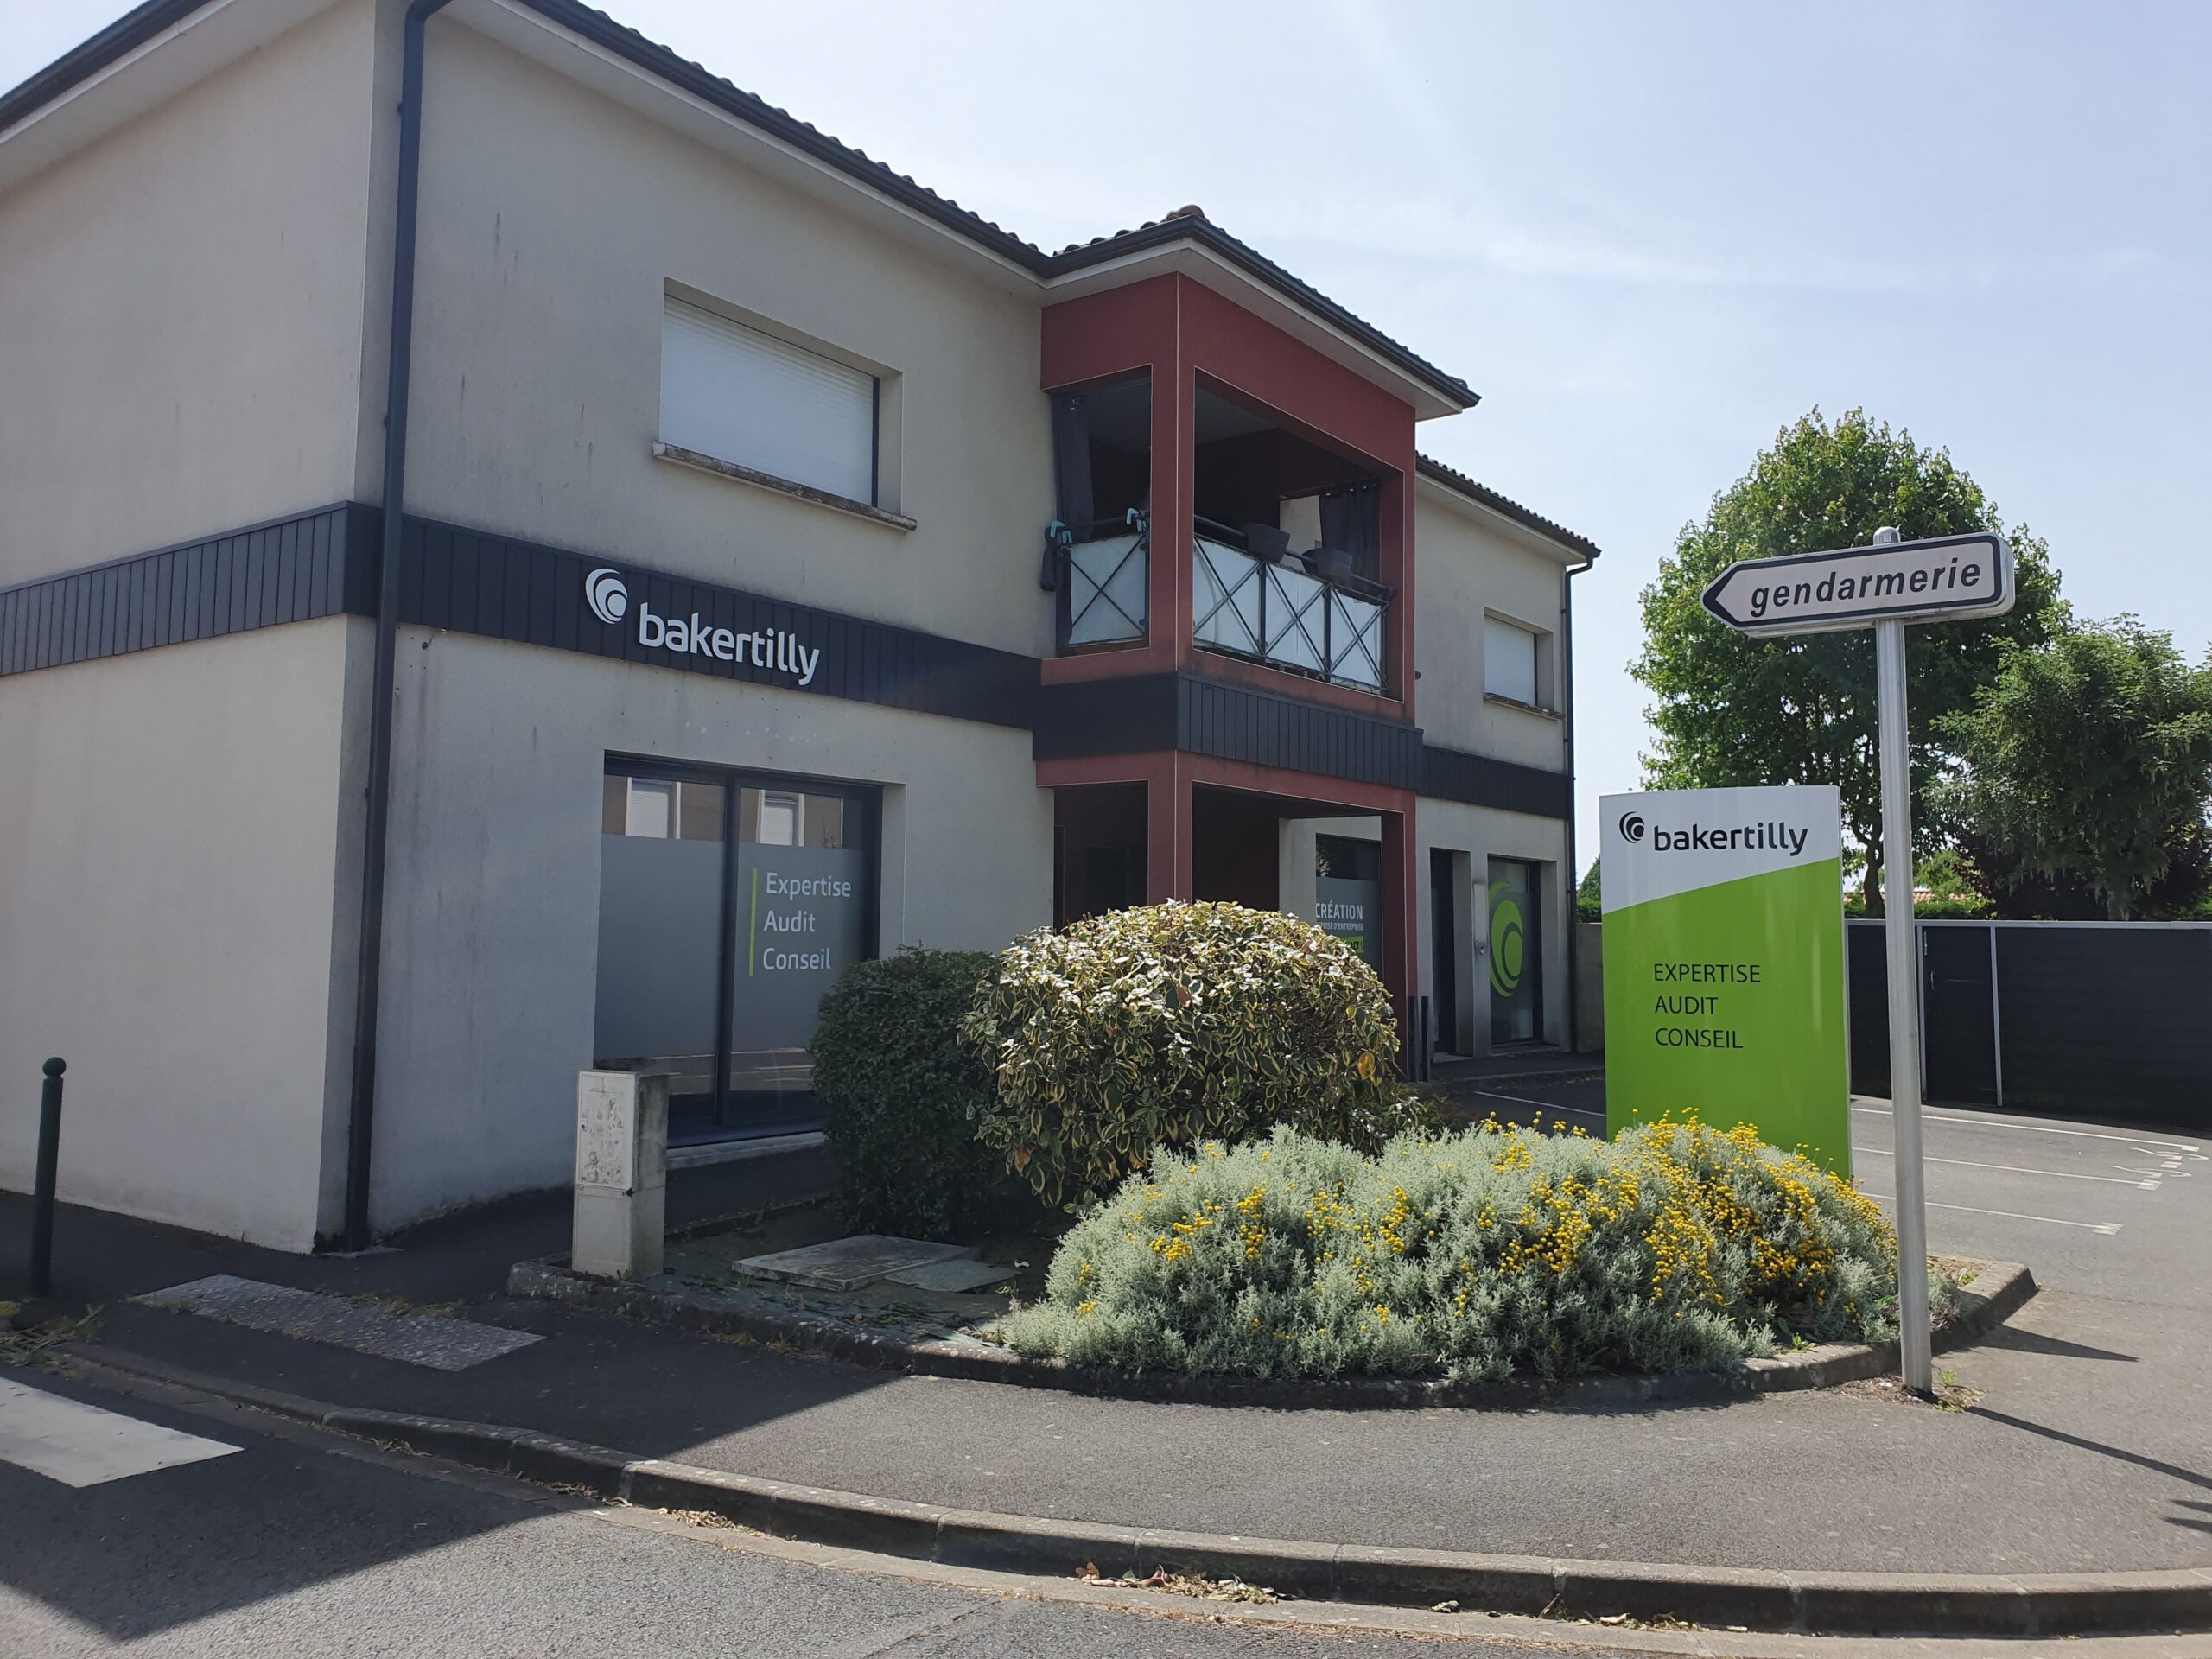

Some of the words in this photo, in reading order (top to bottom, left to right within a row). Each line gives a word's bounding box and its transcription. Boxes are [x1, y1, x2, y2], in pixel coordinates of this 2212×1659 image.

[1750, 557, 1980, 617] gendarmerie
[639, 601, 820, 685] bakertilly
[1654, 821, 1808, 856] bakertilly
[766, 872, 851, 901] Expertise
[763, 909, 816, 932] Audit
[1315, 899, 1363, 920] CRÉATION
[763, 947, 831, 969] Conseil
[1654, 963, 1761, 982] EXPERTISE
[1654, 996, 1719, 1014] AUDIT
[1655, 1028, 1744, 1048] CONSEIL
